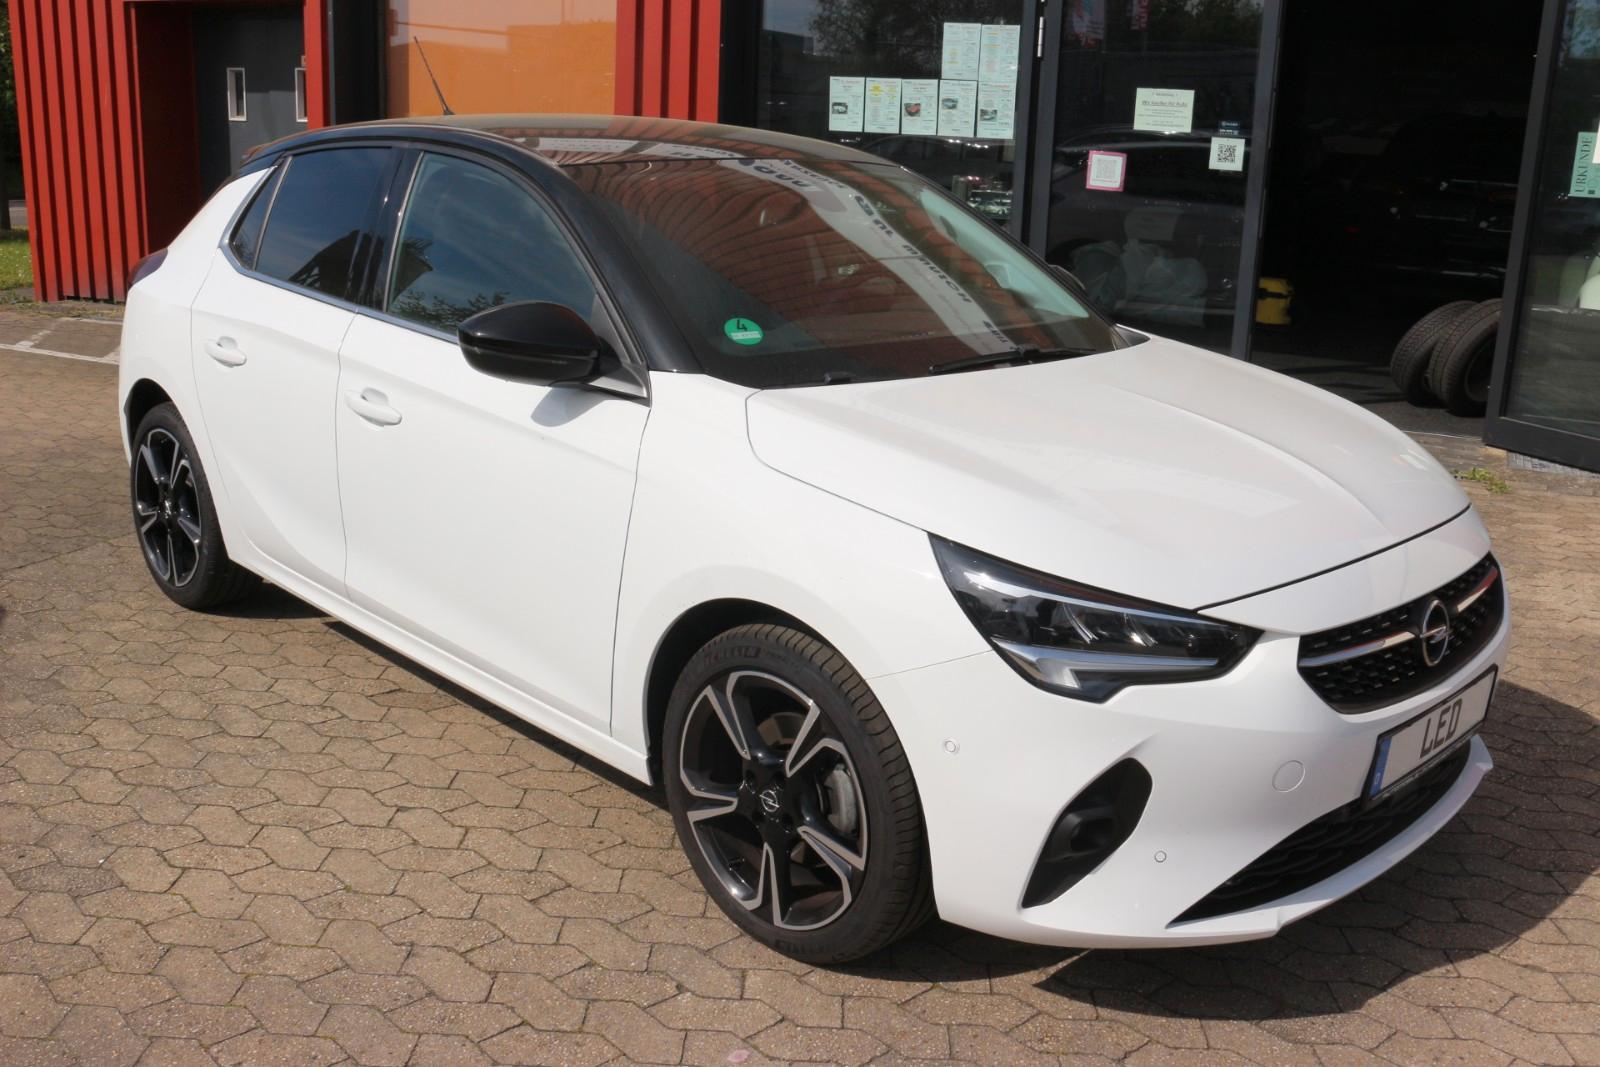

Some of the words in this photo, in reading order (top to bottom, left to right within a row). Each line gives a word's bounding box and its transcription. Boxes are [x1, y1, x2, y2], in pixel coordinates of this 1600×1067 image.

[1574, 137, 1592, 193] URKUNDE
[736, 319, 748, 331] 4
[1419, 697, 1463, 759] LED
